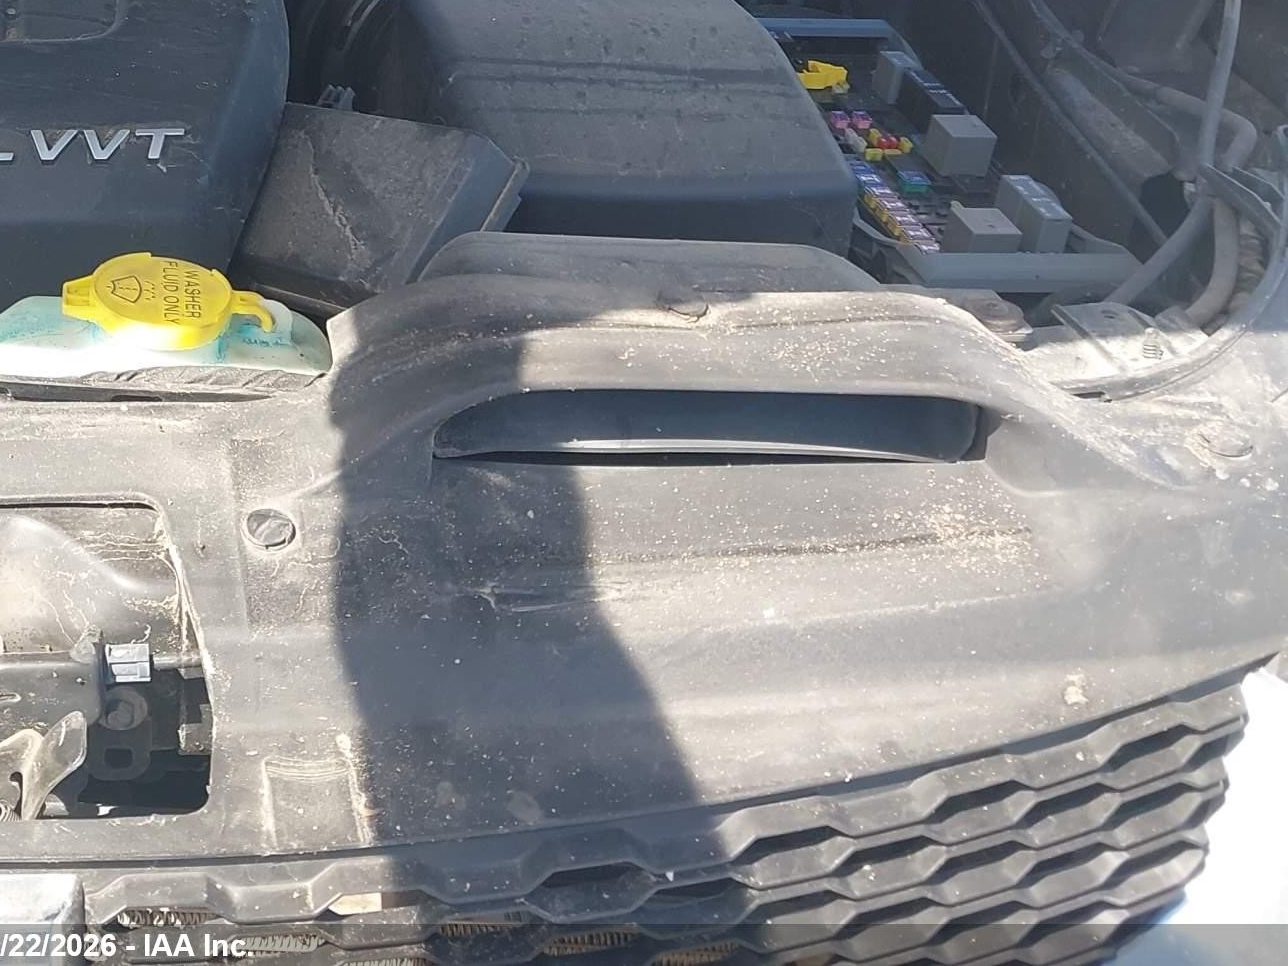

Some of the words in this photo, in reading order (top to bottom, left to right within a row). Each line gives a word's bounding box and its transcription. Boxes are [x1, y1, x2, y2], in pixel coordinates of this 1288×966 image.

[30, 129, 185, 162] VVT
[163, 260, 179, 292] FLUID
[163, 295, 180, 325] ONLY
[183, 270, 201, 318] WASHER
